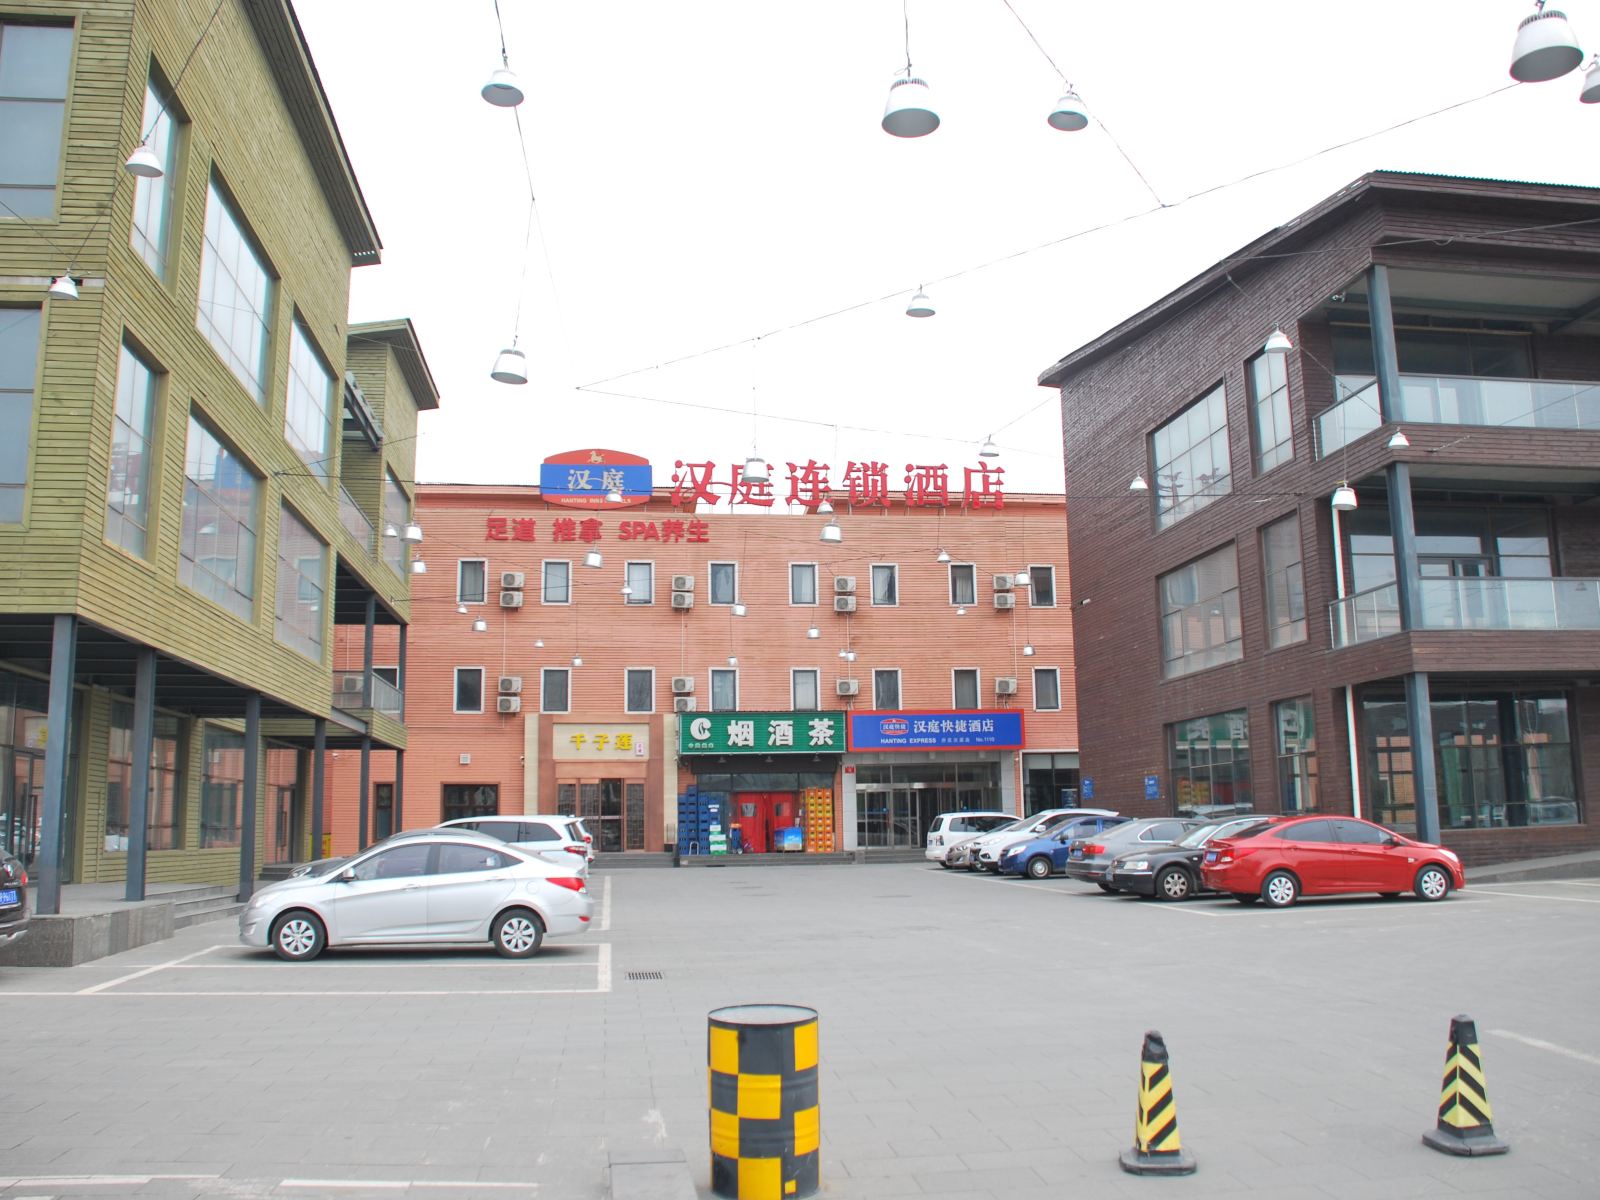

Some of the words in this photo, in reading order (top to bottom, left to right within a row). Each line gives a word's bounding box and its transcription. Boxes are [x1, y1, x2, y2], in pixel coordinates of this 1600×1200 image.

[567, 468, 625, 492] 汉庭
[669, 459, 1005, 509] 汉庭连锁酒店
[485, 517, 536, 542] 足道
[552, 517, 604, 543] 推拿
[727, 718, 835, 747] 烟酒茶
[913, 719, 994, 733] 汉庭快捷酒店
